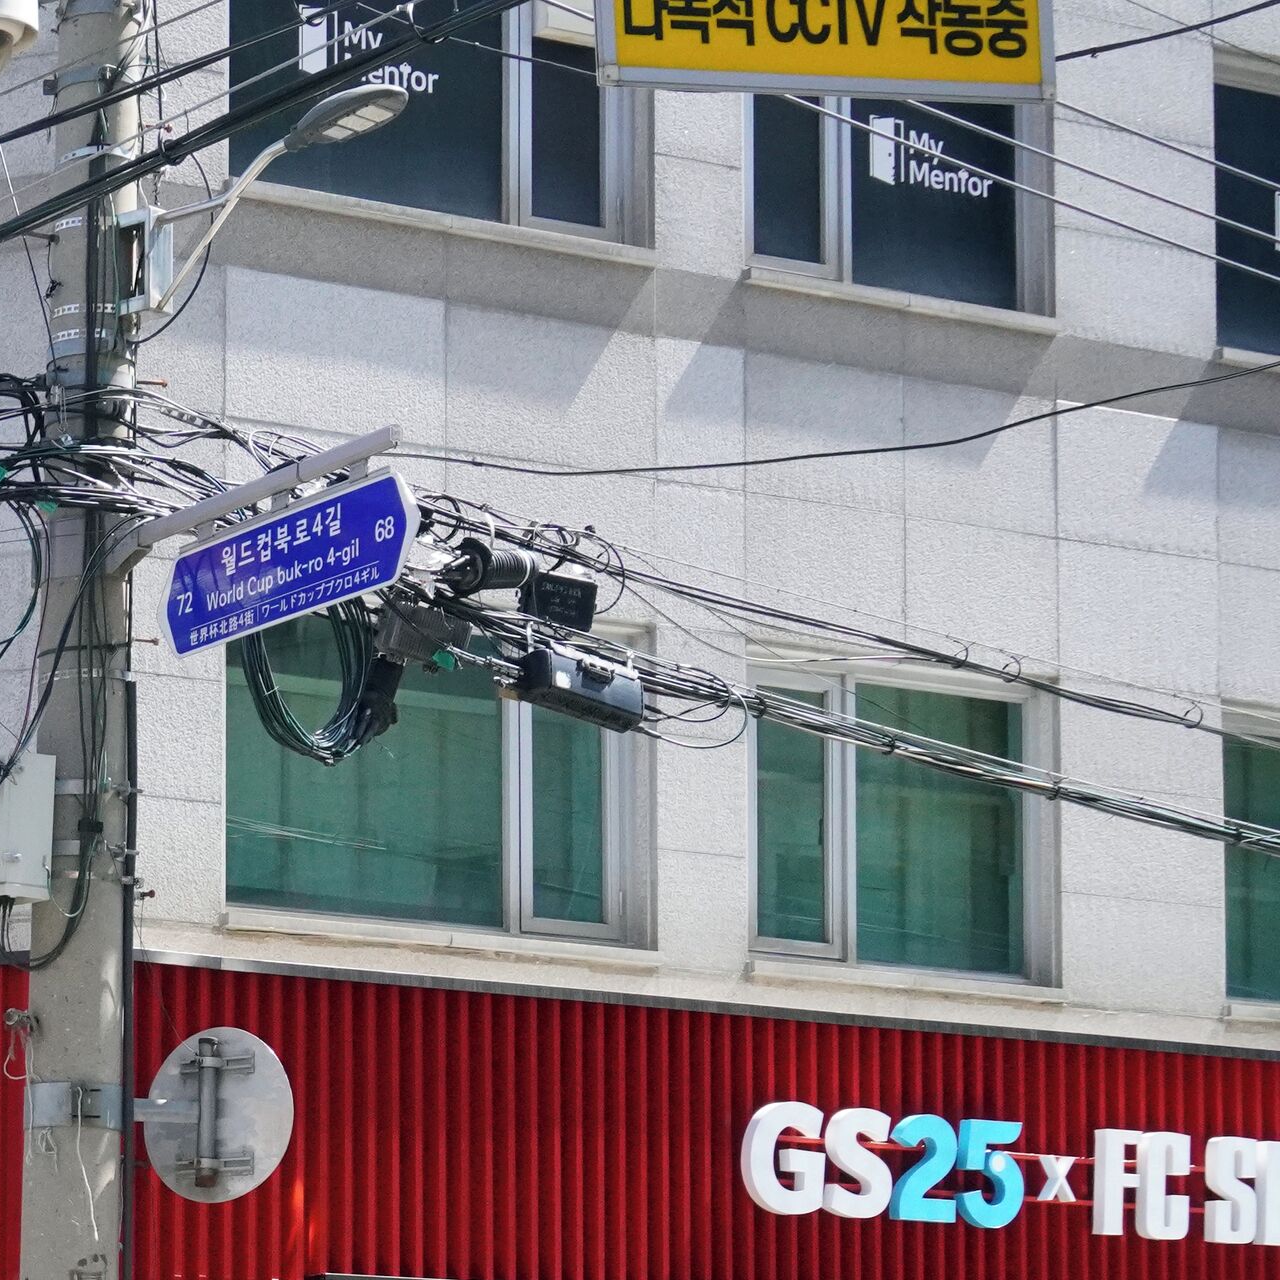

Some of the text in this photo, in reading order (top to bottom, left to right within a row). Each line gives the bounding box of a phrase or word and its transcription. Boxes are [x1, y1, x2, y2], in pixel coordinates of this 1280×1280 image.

[344, 53, 439, 93] entor
[909, 130, 944, 165] My
[909, 160, 993, 198] Mentor
[221, 502, 341, 577] 월드컵북로4길
[375, 515, 395, 542] 68
[206, 538, 360, 612] World Cup buk-ro 4-gil
[176, 591, 193, 616] 72
[740, 1100, 1025, 1229] GS25
[1092, 1128, 1192, 1240] FC
